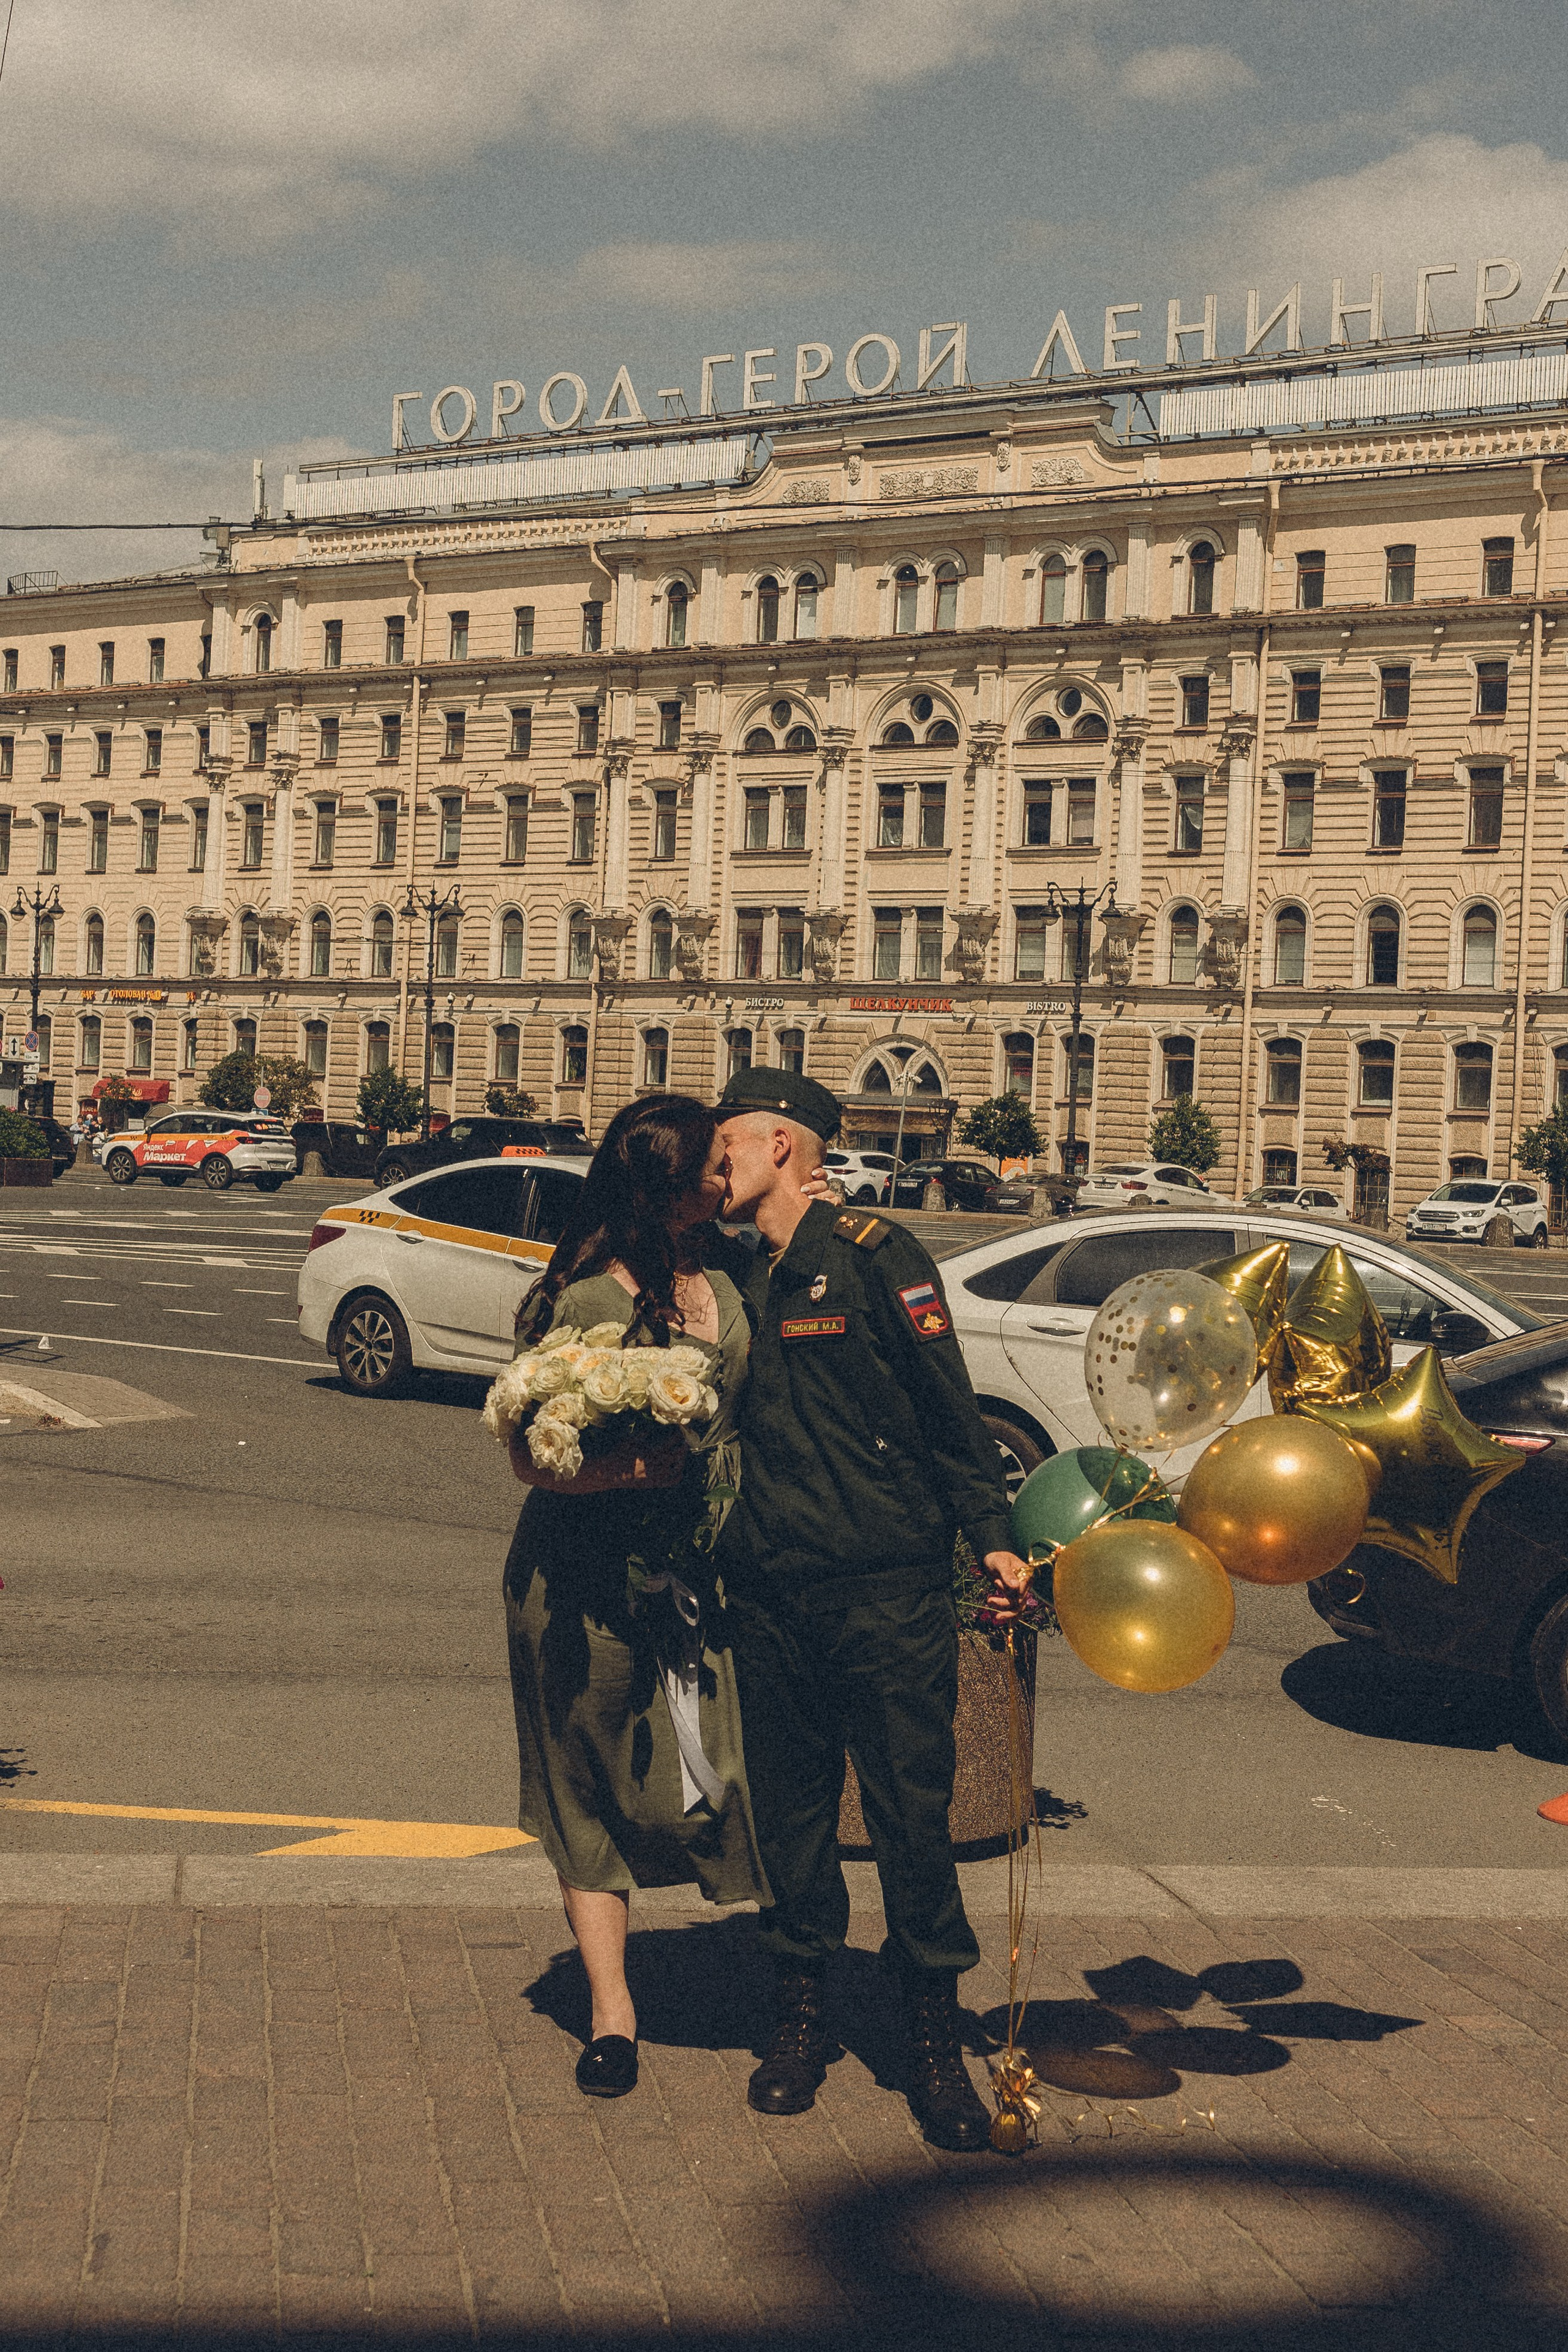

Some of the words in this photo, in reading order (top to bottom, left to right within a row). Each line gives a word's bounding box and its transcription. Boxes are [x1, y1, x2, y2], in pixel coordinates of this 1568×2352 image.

[392, 322, 967, 450] ГОРОД-ГЕРОЙ
[745, 997, 784, 1007] БИСТРО
[850, 997, 953, 1011] ЩЕЛКУНЧИК
[1027, 1001, 1066, 1011] BISTRO
[143, 1152, 186, 1163] Маркет
[787, 1321, 818, 1333] ГОНСКИЙ
[822, 1321, 839, 1330] М.А.
